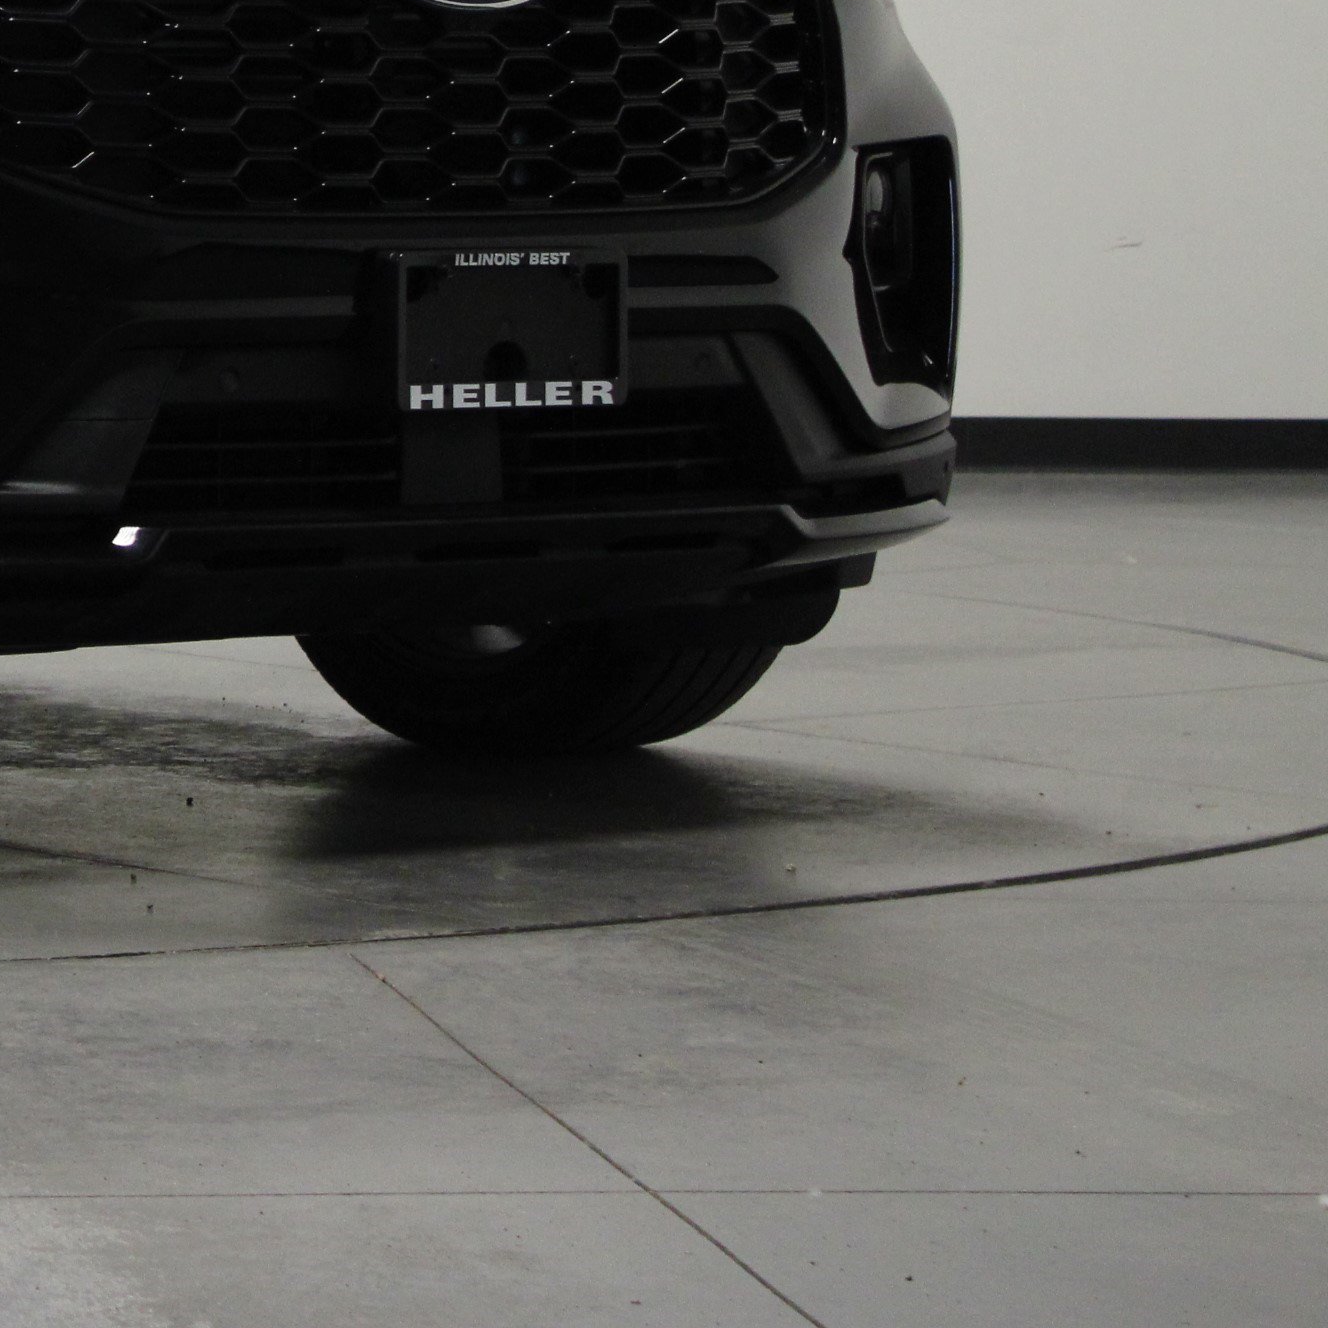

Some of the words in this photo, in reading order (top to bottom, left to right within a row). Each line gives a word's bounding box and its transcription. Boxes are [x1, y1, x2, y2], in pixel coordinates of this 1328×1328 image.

[455, 253, 524, 266] ILLINOIS'
[529, 252, 570, 265] BEST
[409, 380, 614, 410] HELLER
